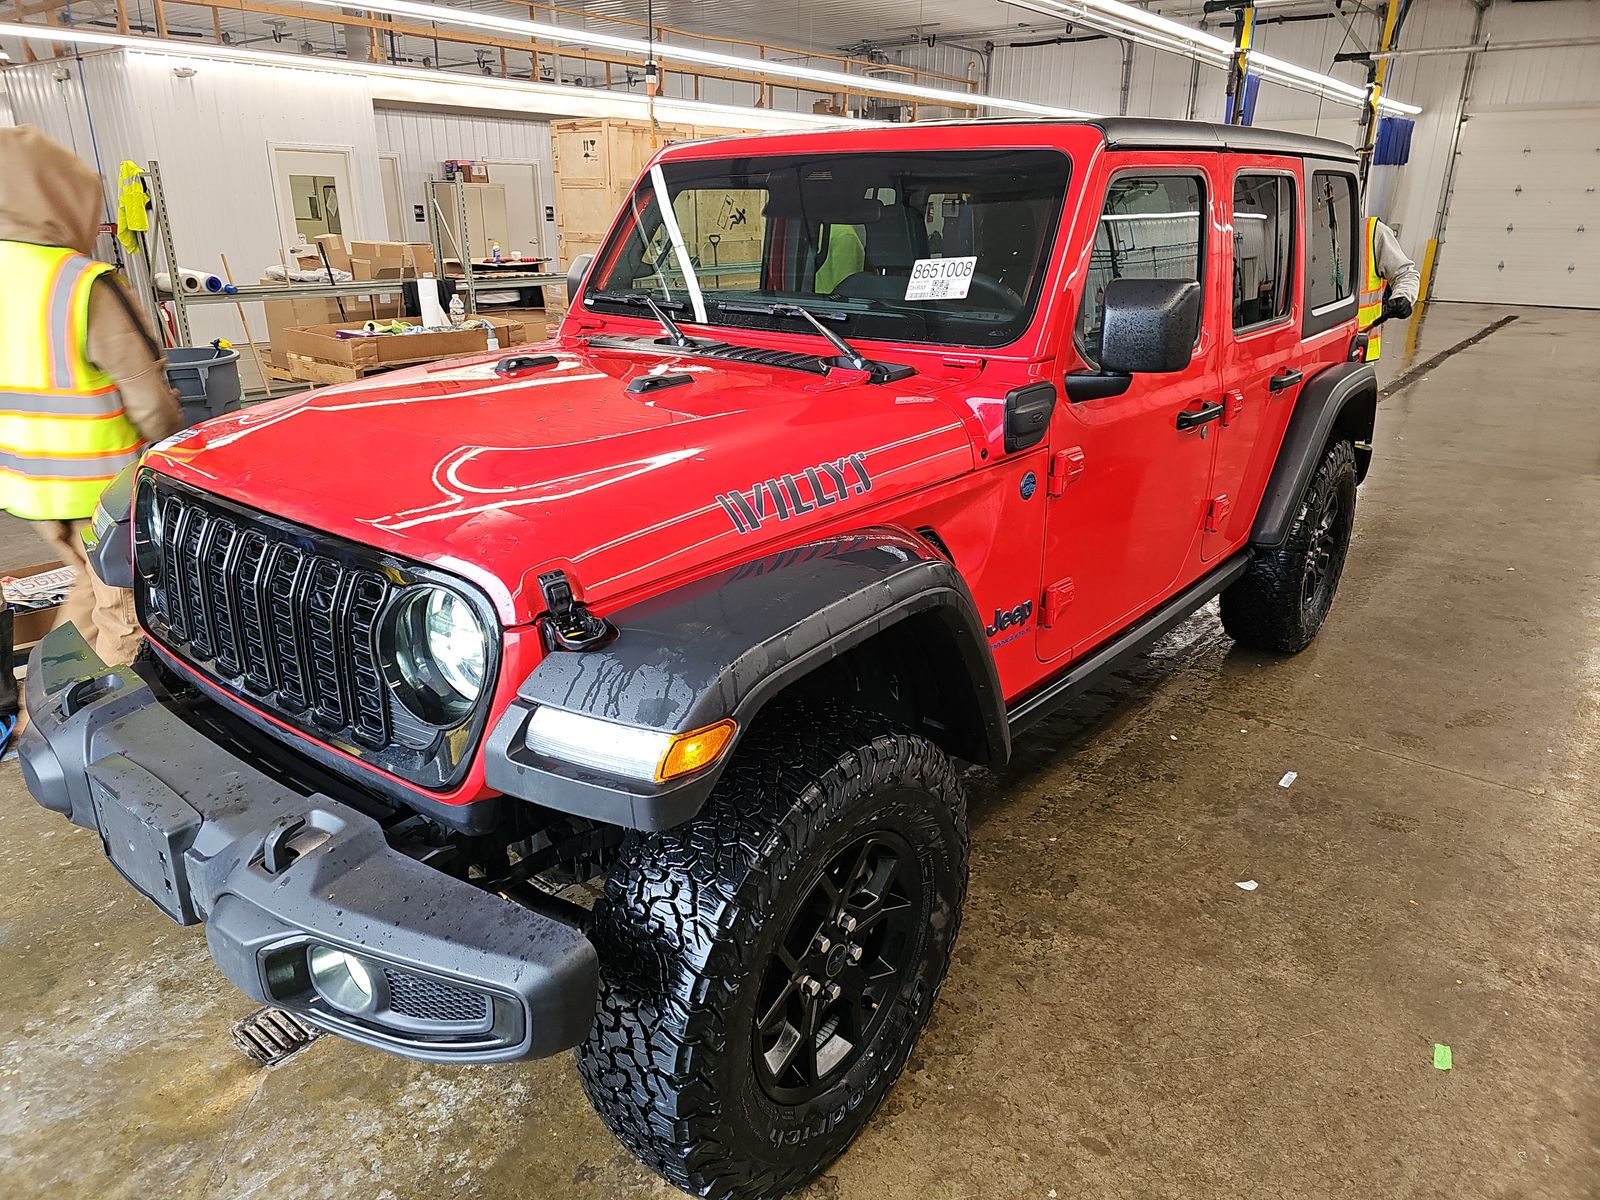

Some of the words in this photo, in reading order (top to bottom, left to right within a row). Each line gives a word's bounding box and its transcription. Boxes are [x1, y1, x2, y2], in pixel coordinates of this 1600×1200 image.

[913, 261, 973, 279] 8651008
[716, 452, 872, 534] WILLYS
[986, 599, 1032, 637] Jeep
